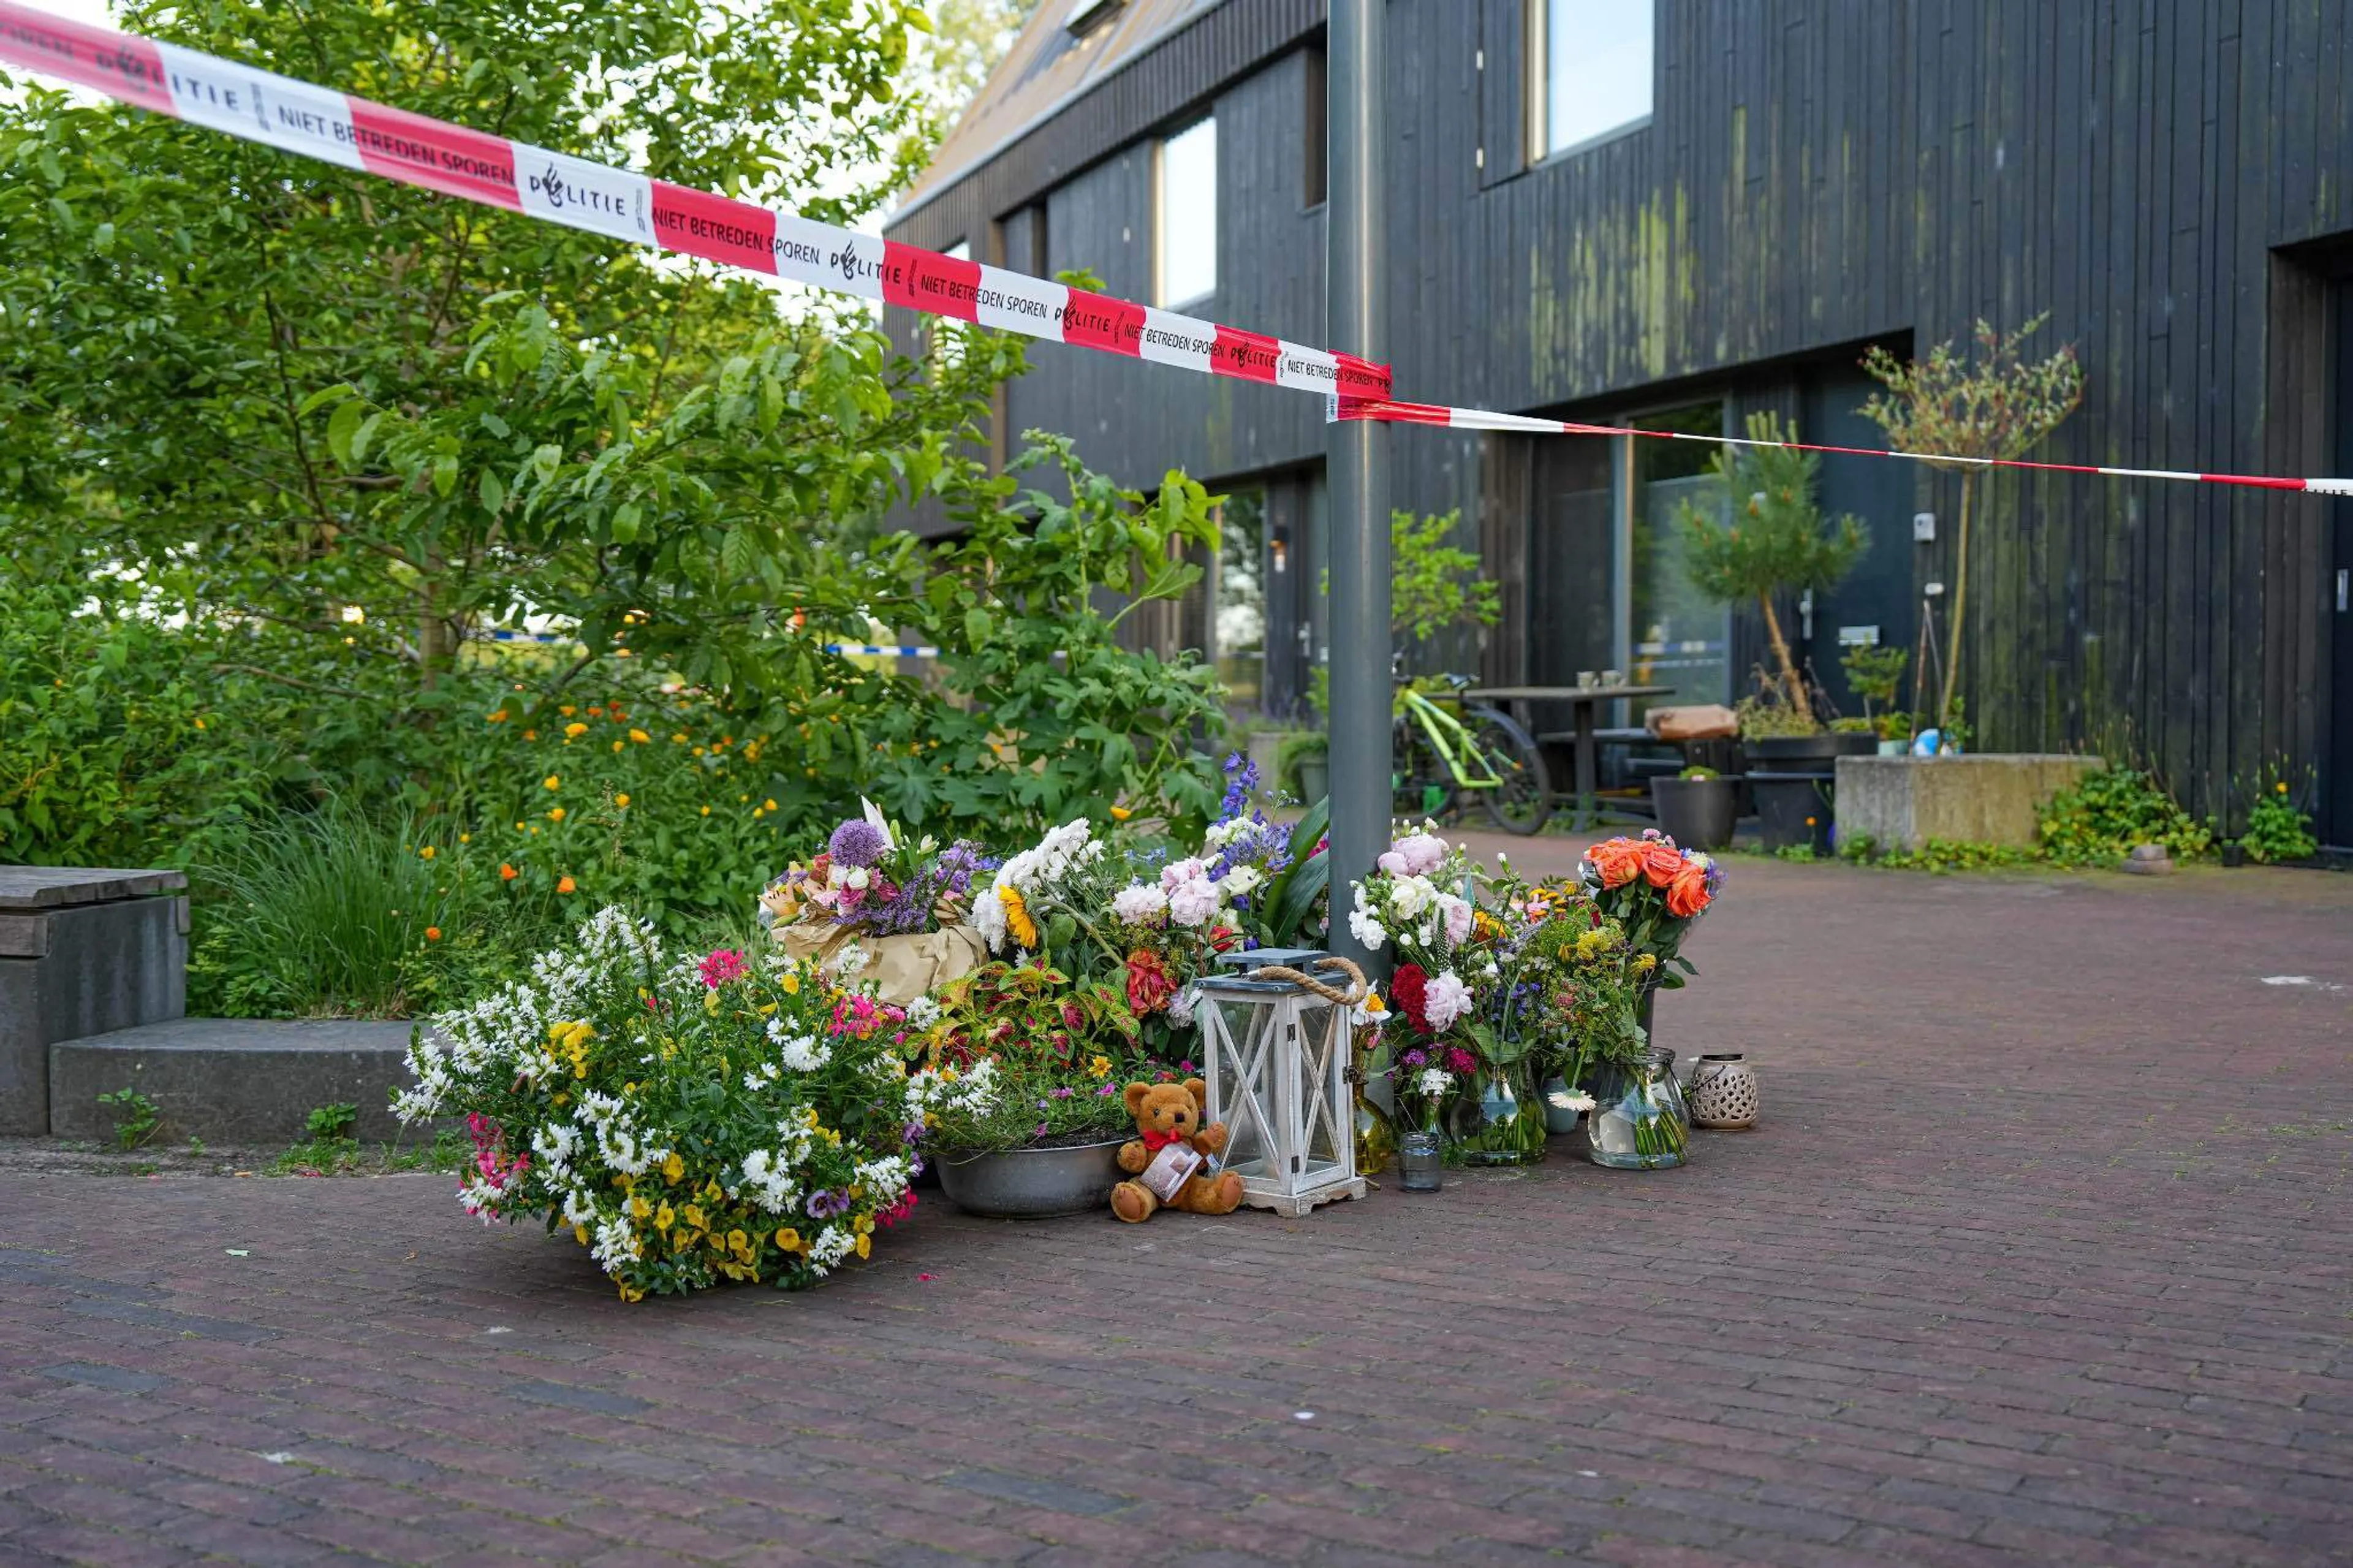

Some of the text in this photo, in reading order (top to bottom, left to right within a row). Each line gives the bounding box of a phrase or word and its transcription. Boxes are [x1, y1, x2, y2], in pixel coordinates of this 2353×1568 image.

[278, 104, 325, 135] NIET
[333, 121, 436, 166] BETREDEN
[441, 151, 515, 187] SPOREN
[653, 206, 688, 232] NIET
[690, 216, 762, 251] BETREDEN
[767, 238, 820, 264] SPOREN
[921, 274, 946, 295] NIET
[949, 281, 1005, 308] BETREDEN
[1007, 296, 1048, 320] SPOREN
[1124, 324, 1145, 339] NIET
[1146, 328, 1190, 350] BETREDEN
[1192, 338, 1226, 358] SPOREN
[1288, 360, 1305, 374] NIET
[1306, 363, 1342, 381] BETREDEN
[1344, 370, 1373, 387] SPOREN
